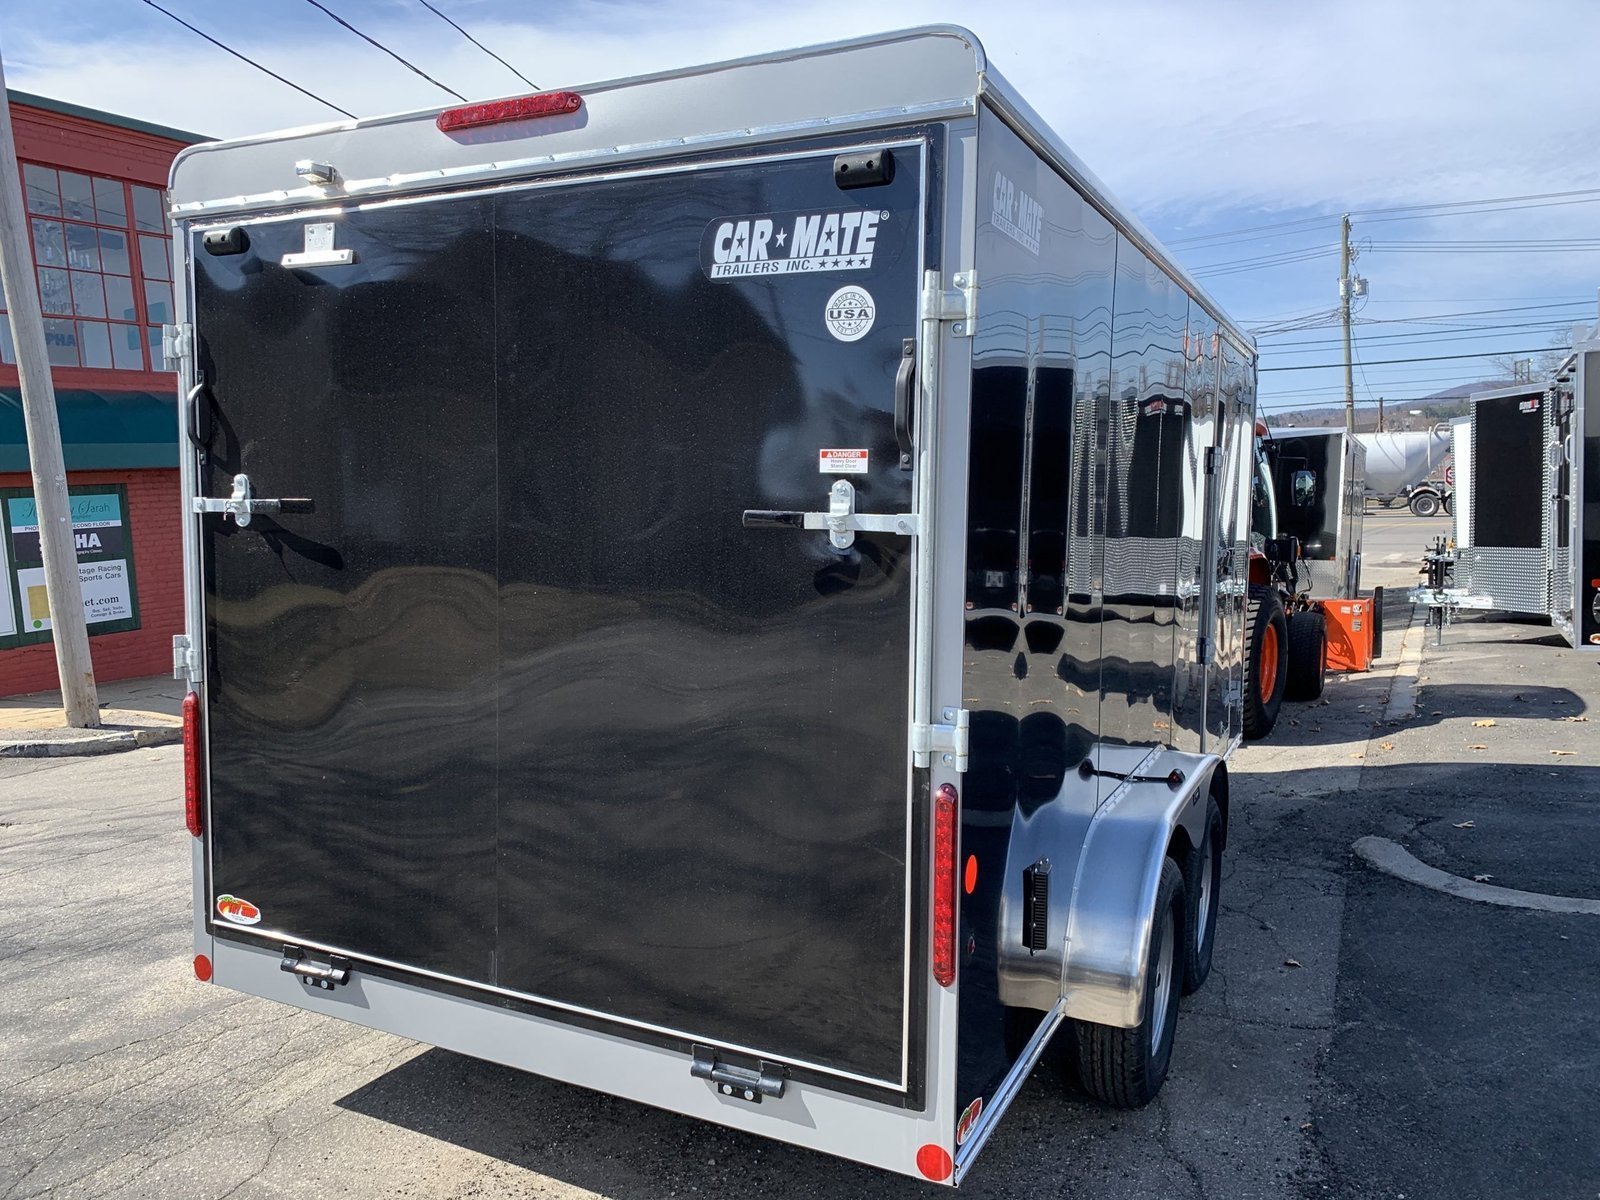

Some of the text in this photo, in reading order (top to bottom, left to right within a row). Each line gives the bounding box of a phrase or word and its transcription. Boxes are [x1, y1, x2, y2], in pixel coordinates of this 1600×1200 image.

[993, 171, 1042, 243] CAR MATE
[714, 210, 881, 264] CAR MATE
[715, 259, 814, 276] TRAILERS INC.
[829, 309, 870, 320] USA
[78, 500, 111, 515] Sarah
[98, 565, 122, 573] Racing
[79, 575, 103, 583] Sports
[84, 596, 119, 607] et.com
